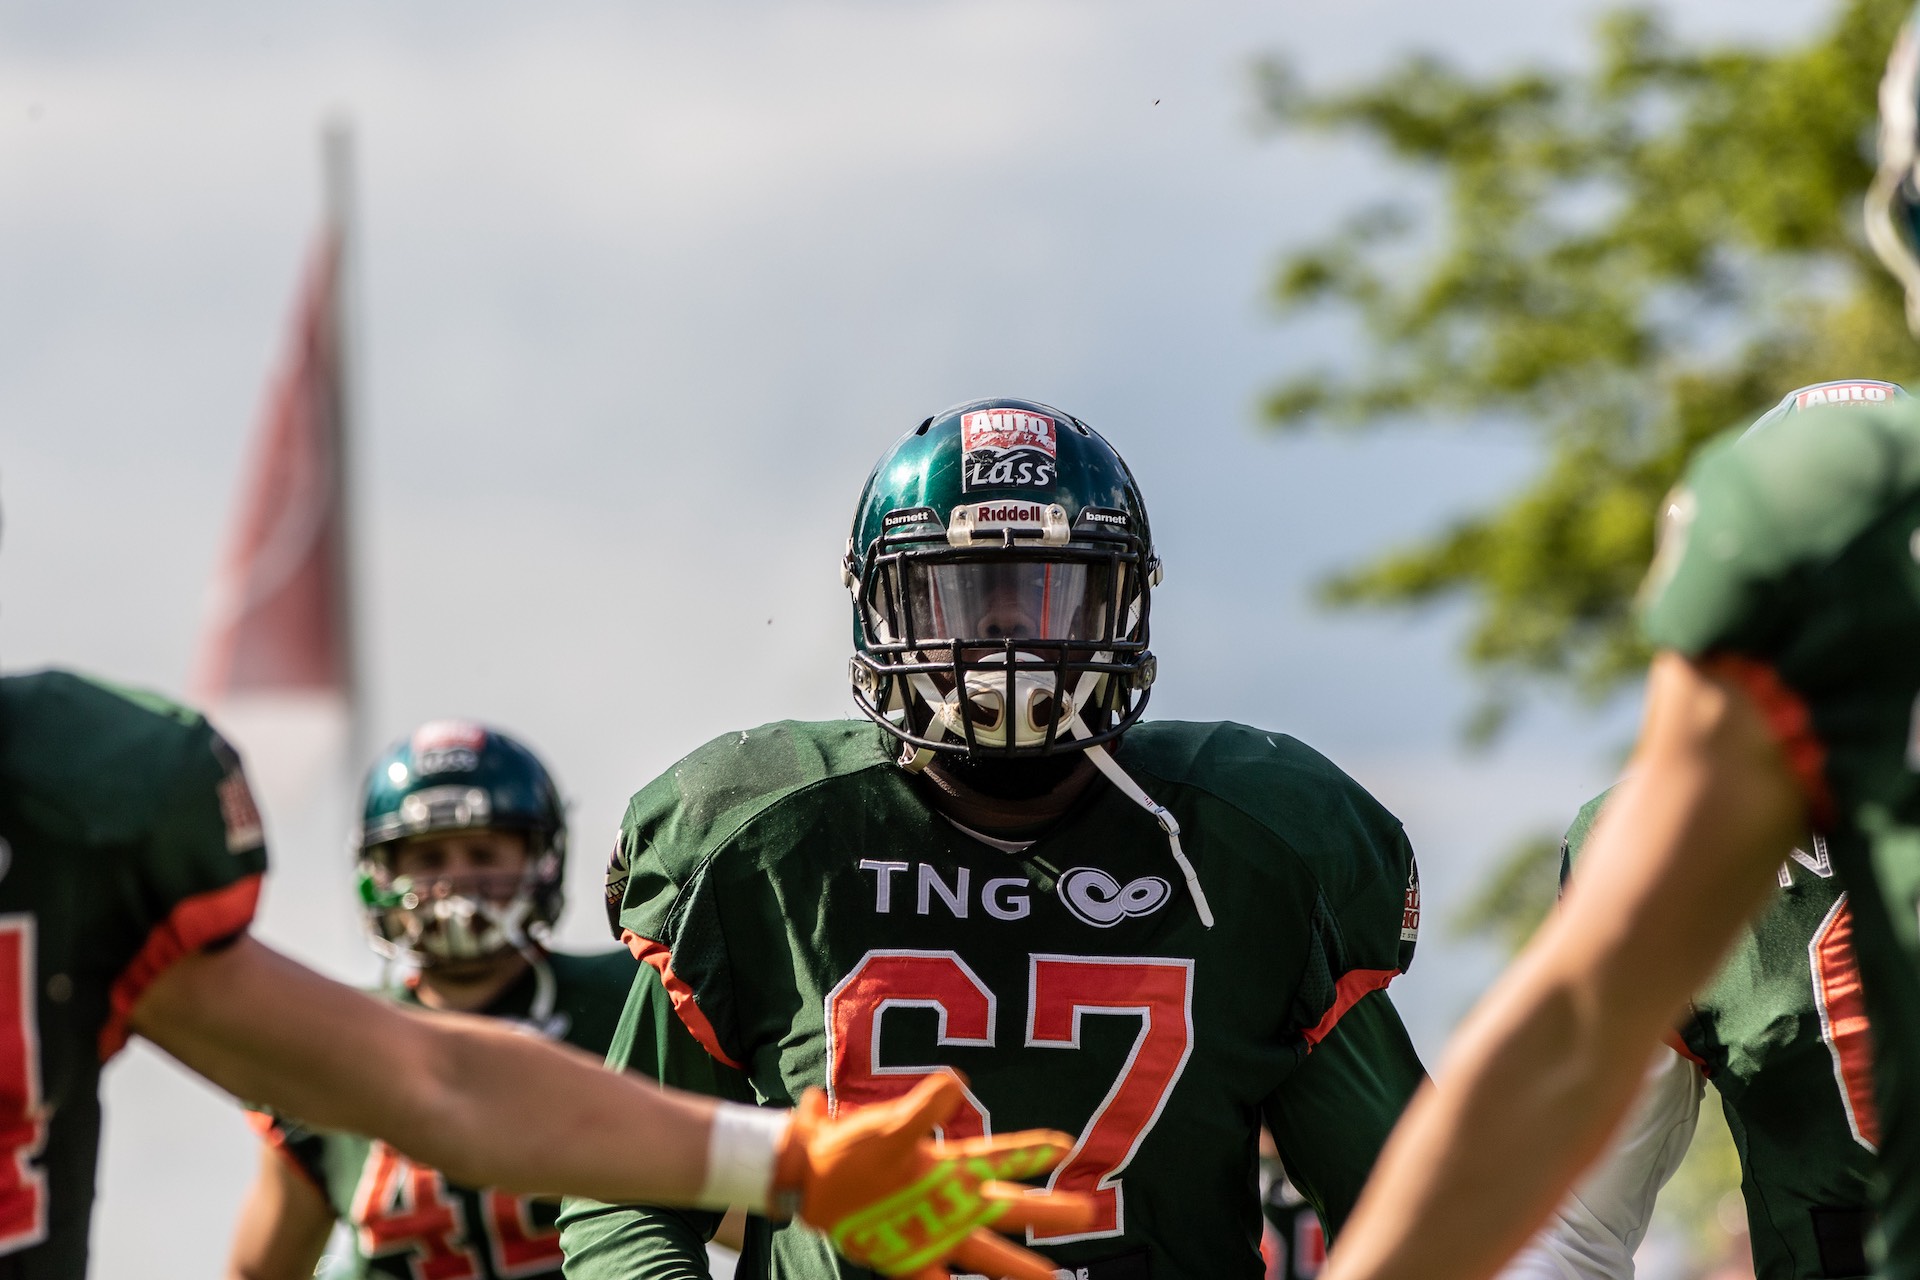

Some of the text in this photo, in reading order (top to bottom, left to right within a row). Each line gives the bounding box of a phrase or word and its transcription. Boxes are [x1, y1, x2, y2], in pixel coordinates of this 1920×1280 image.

[1805, 386, 1887, 408] Auto
[970, 413, 1048, 436] Auto
[971, 460, 1050, 486] Lass
[885, 511, 929, 527] barnett
[978, 506, 1041, 522] Riddell
[1086, 511, 1127, 526] barnett
[859, 858, 1031, 921] TNG
[825, 949, 1195, 1246] 67
